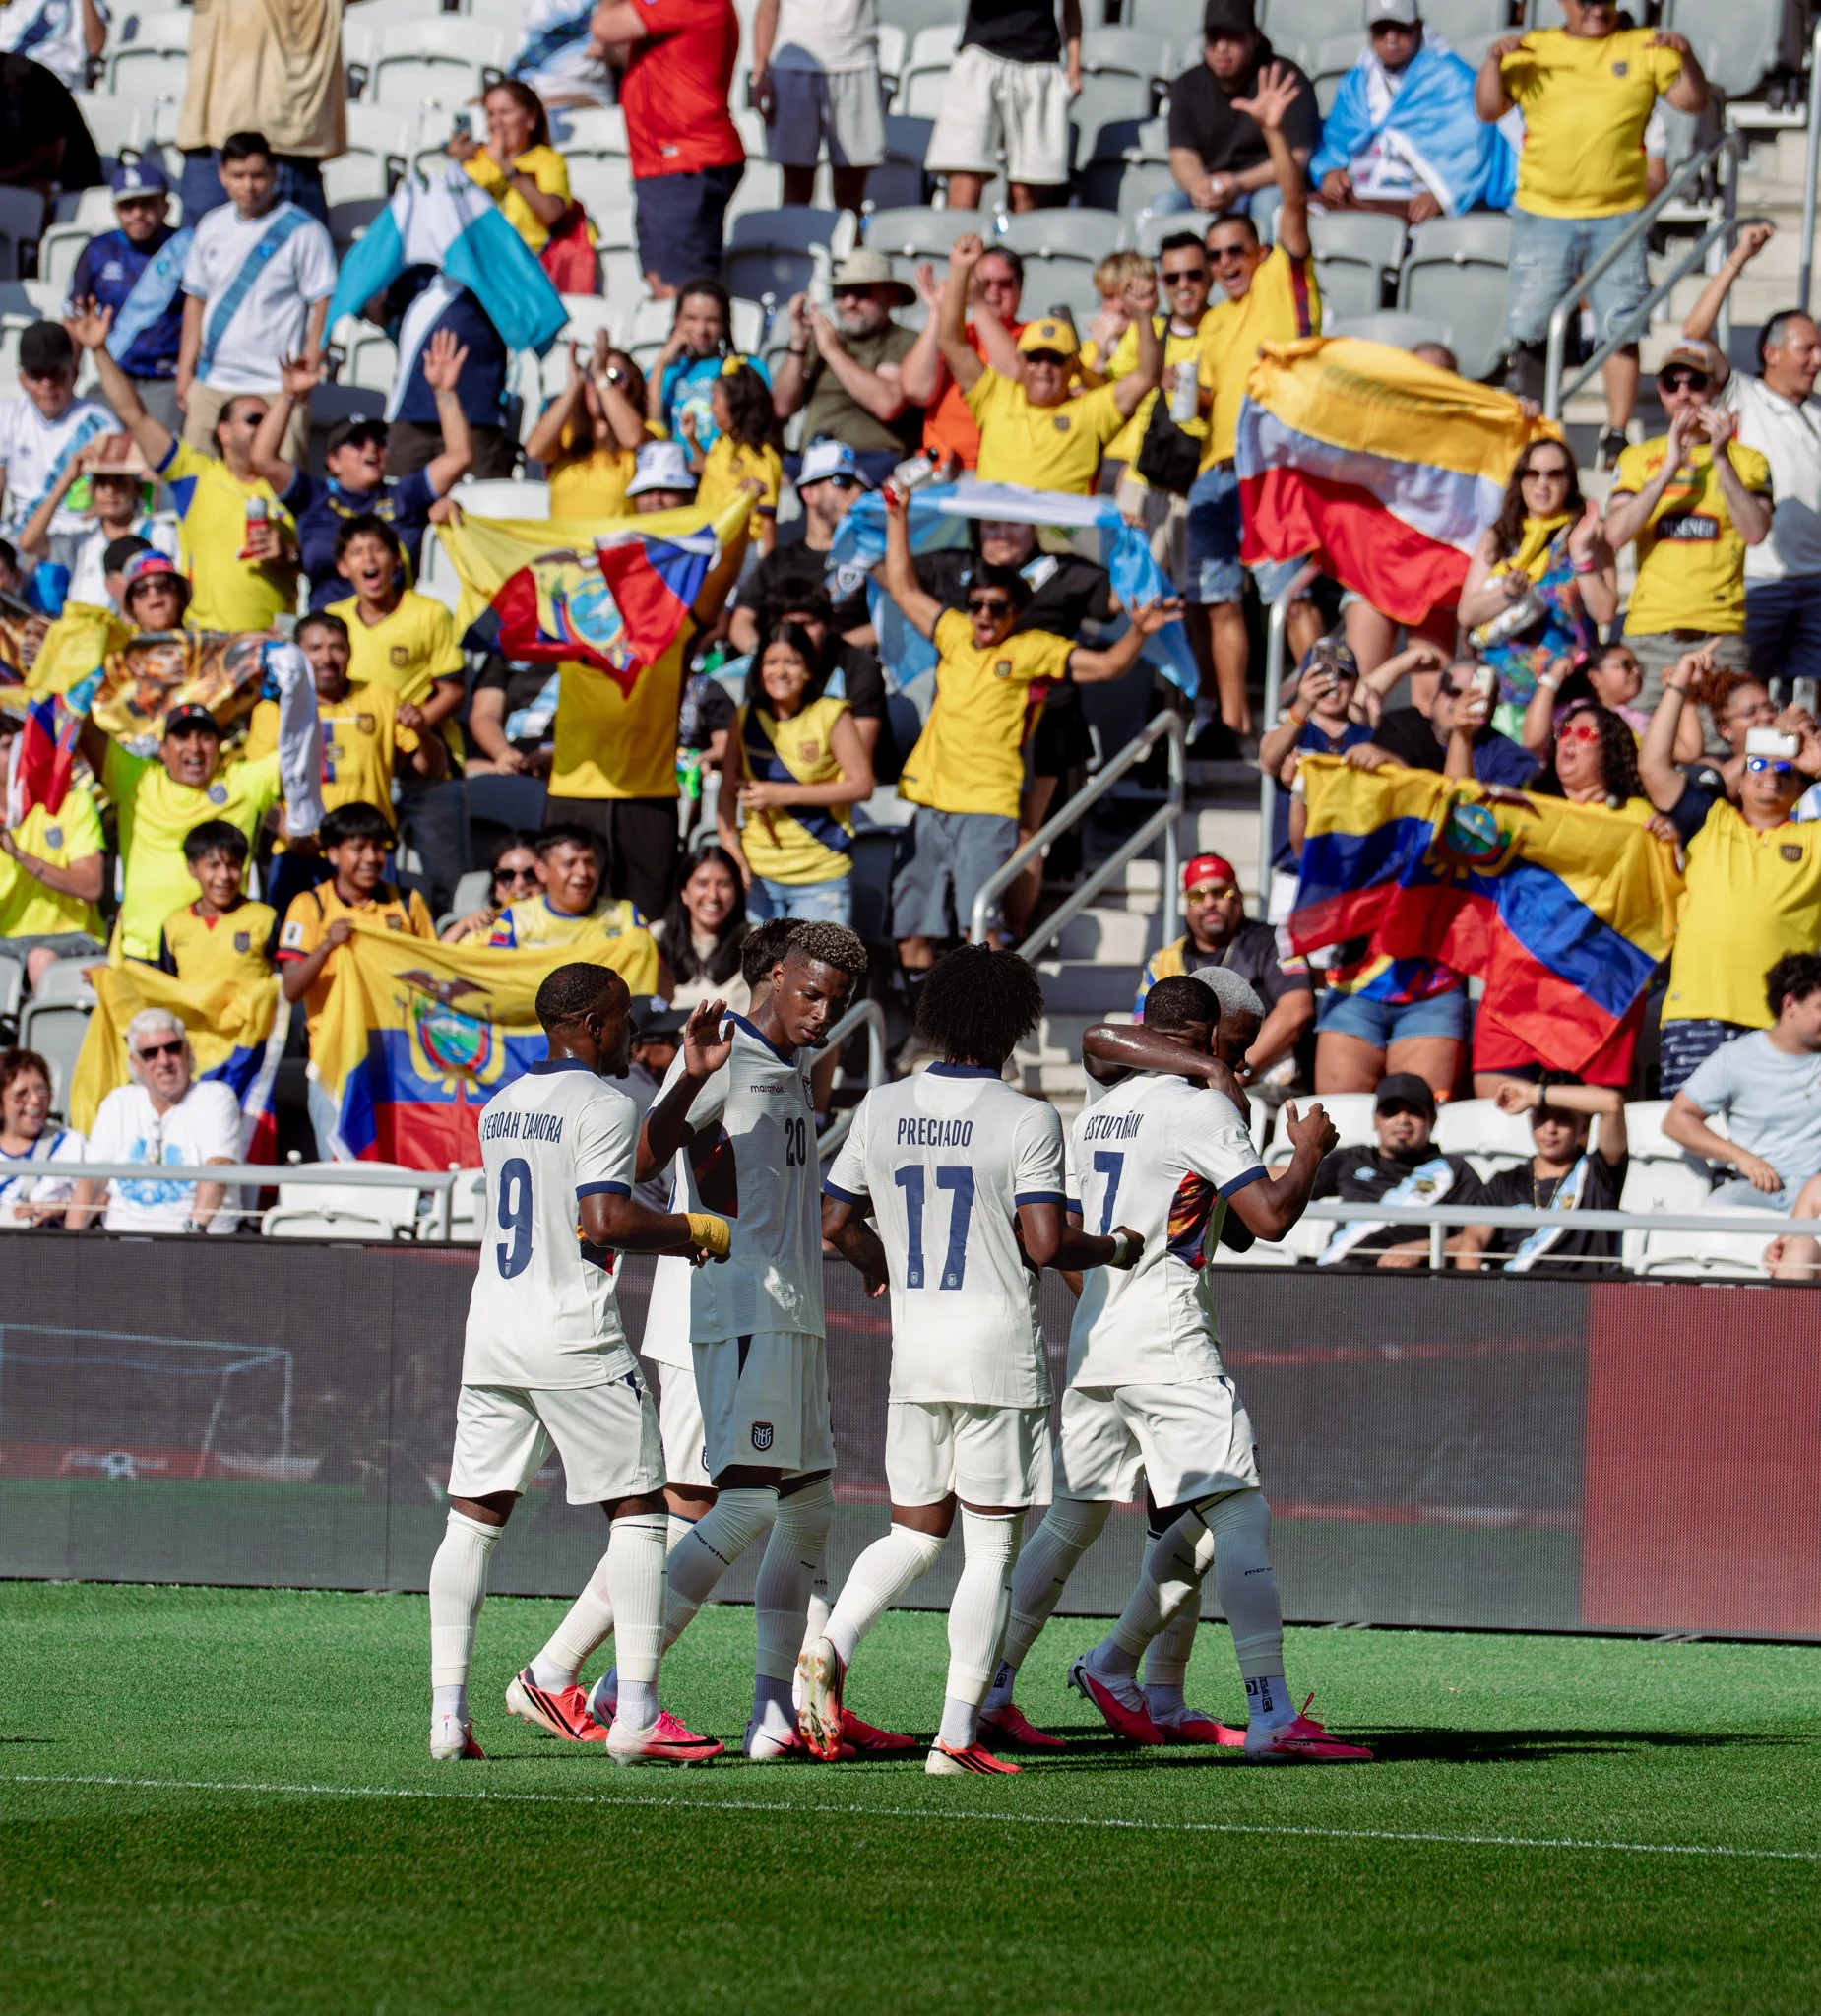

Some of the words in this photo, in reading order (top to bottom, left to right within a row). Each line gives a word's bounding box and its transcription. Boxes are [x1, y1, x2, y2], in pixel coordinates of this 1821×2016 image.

[482, 1111, 521, 1141] YEBOAH
[522, 1112, 564, 1144] ZAMORA
[785, 1117, 806, 1166] 20
[897, 1117, 973, 1147] PRECIADO
[496, 1157, 534, 1280] 9
[1093, 1150, 1125, 1236] 7
[894, 1164, 975, 1291] 17
